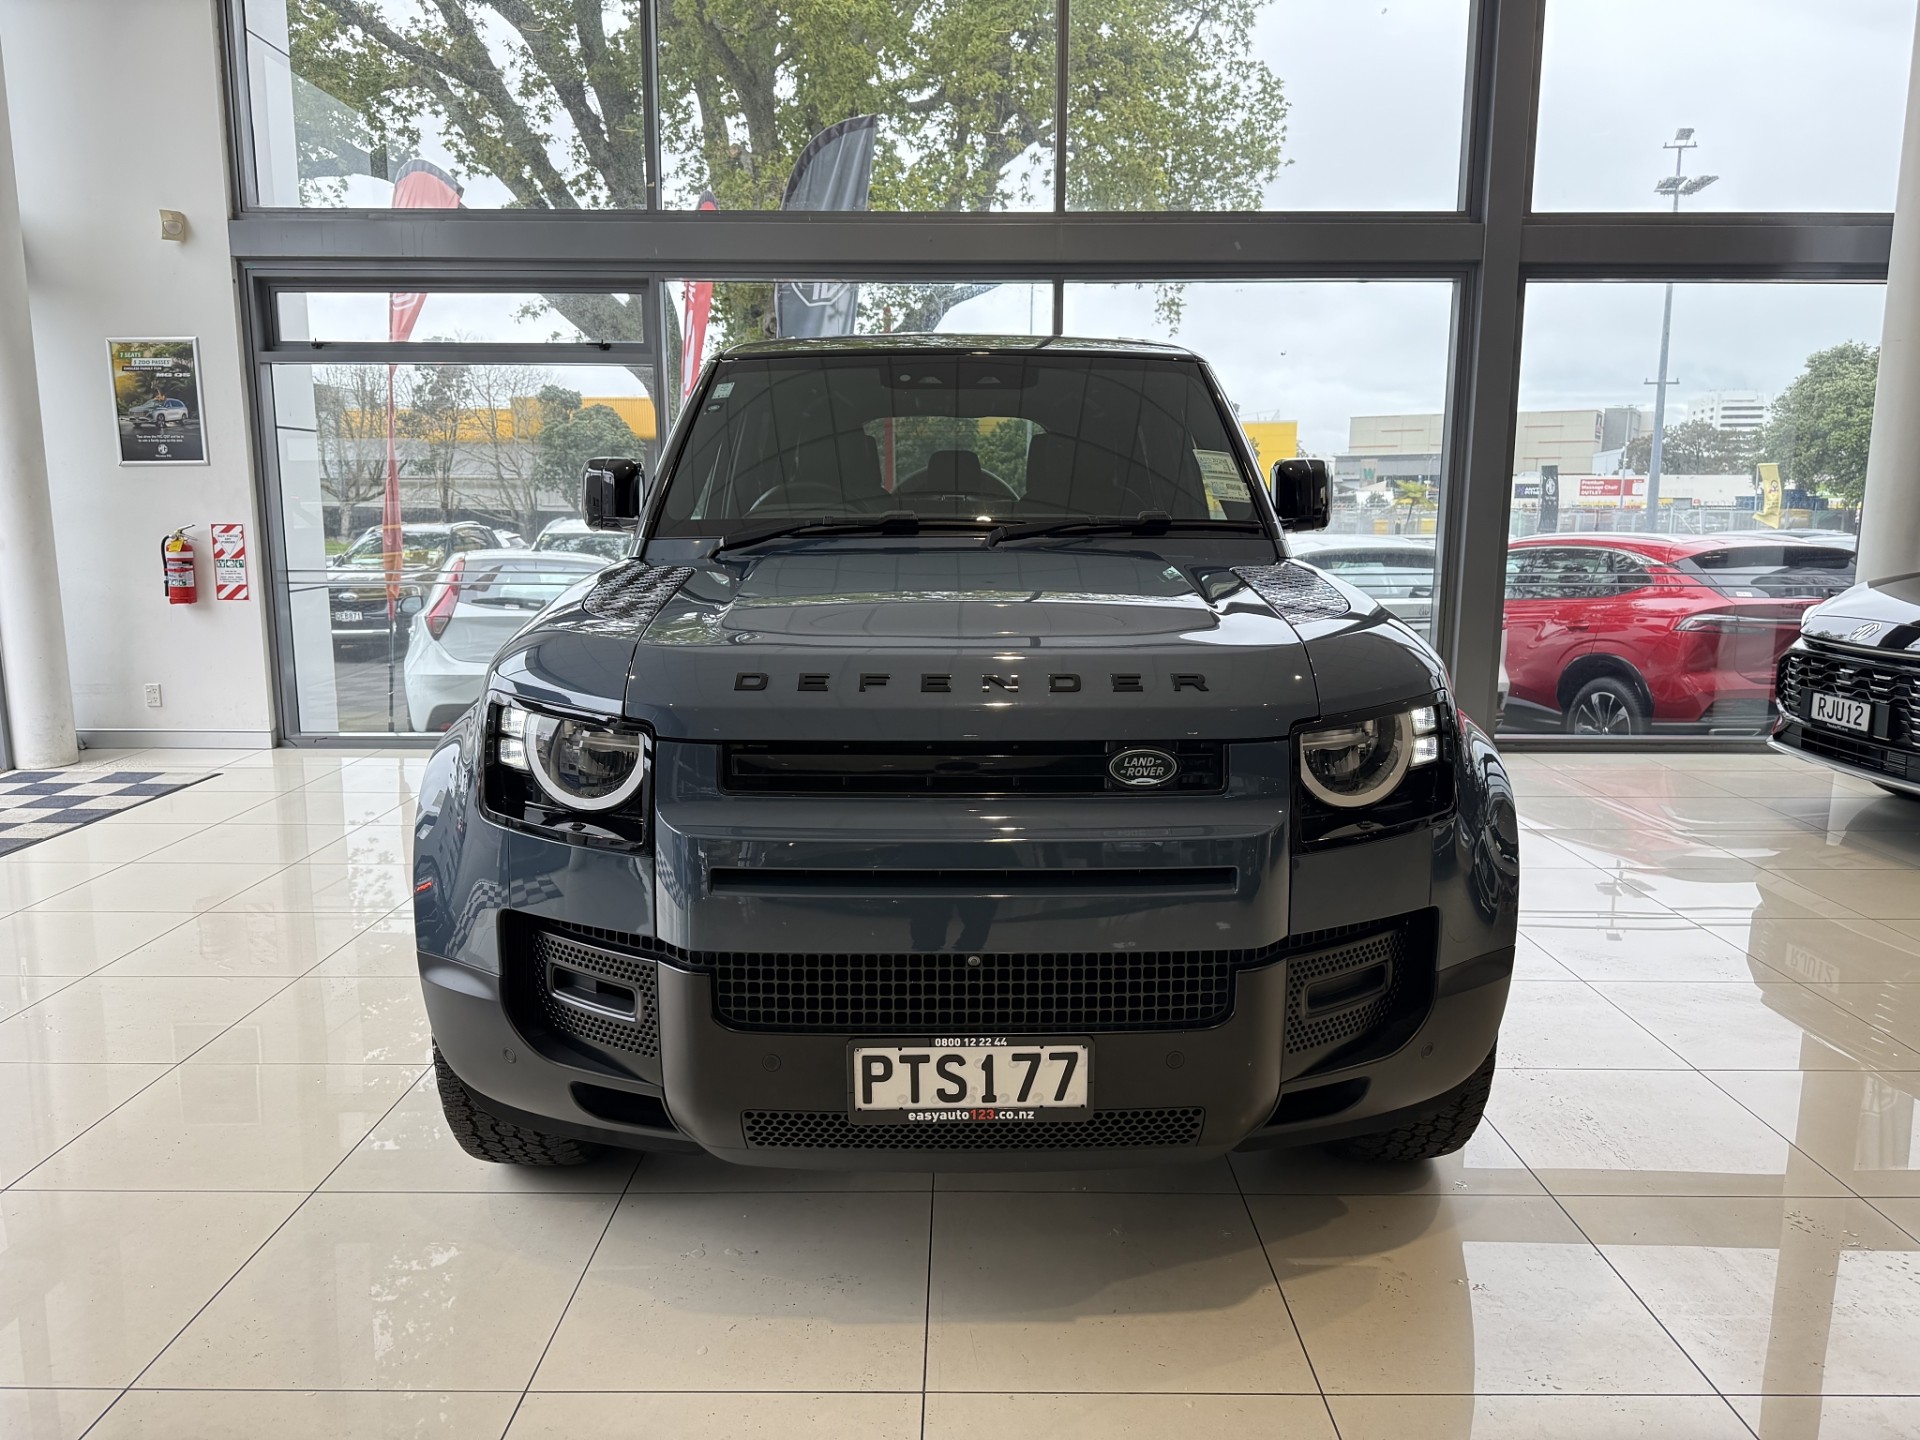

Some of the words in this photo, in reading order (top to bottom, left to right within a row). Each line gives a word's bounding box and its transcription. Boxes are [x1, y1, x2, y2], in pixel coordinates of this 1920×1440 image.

[733, 672, 1210, 693] DEFENDER
[1818, 696, 1864, 726] RJU12
[1124, 757, 1154, 766] LAND
[1127, 767, 1164, 776] ROVER
[935, 1038, 961, 1046] 0800
[964, 1038, 976, 1046] 12
[979, 1038, 991, 1046] 22
[994, 1038, 1007, 1046] 44
[862, 1052, 1078, 1104] PTS177
[908, 1110, 1034, 1122] easyauto123.co.nz
